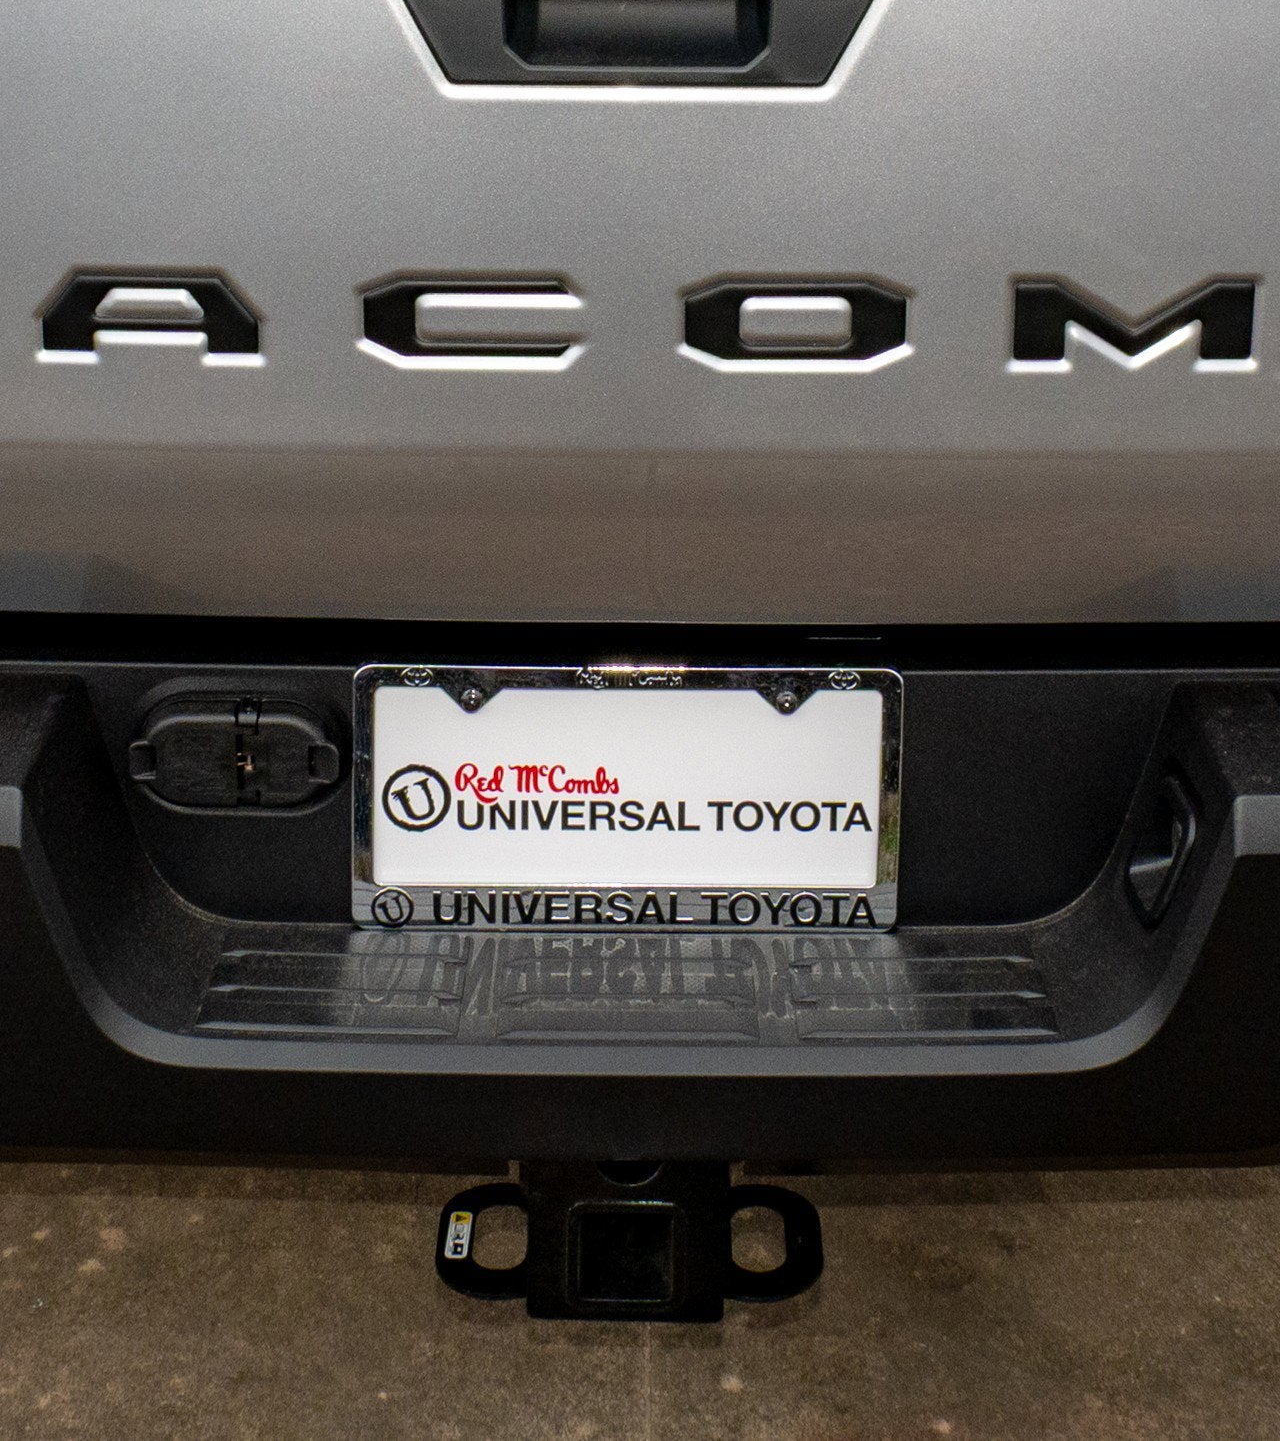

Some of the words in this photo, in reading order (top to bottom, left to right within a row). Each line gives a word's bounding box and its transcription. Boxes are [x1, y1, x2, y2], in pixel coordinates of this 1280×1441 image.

[455, 764, 505, 804] Red
[508, 764, 620, 795] McCombs
[457, 799, 701, 832] UNIVERSAL
[707, 800, 873, 832] TOYOTA
[432, 889, 694, 925] UNIVERSAL
[700, 890, 877, 926] TOYOTA
